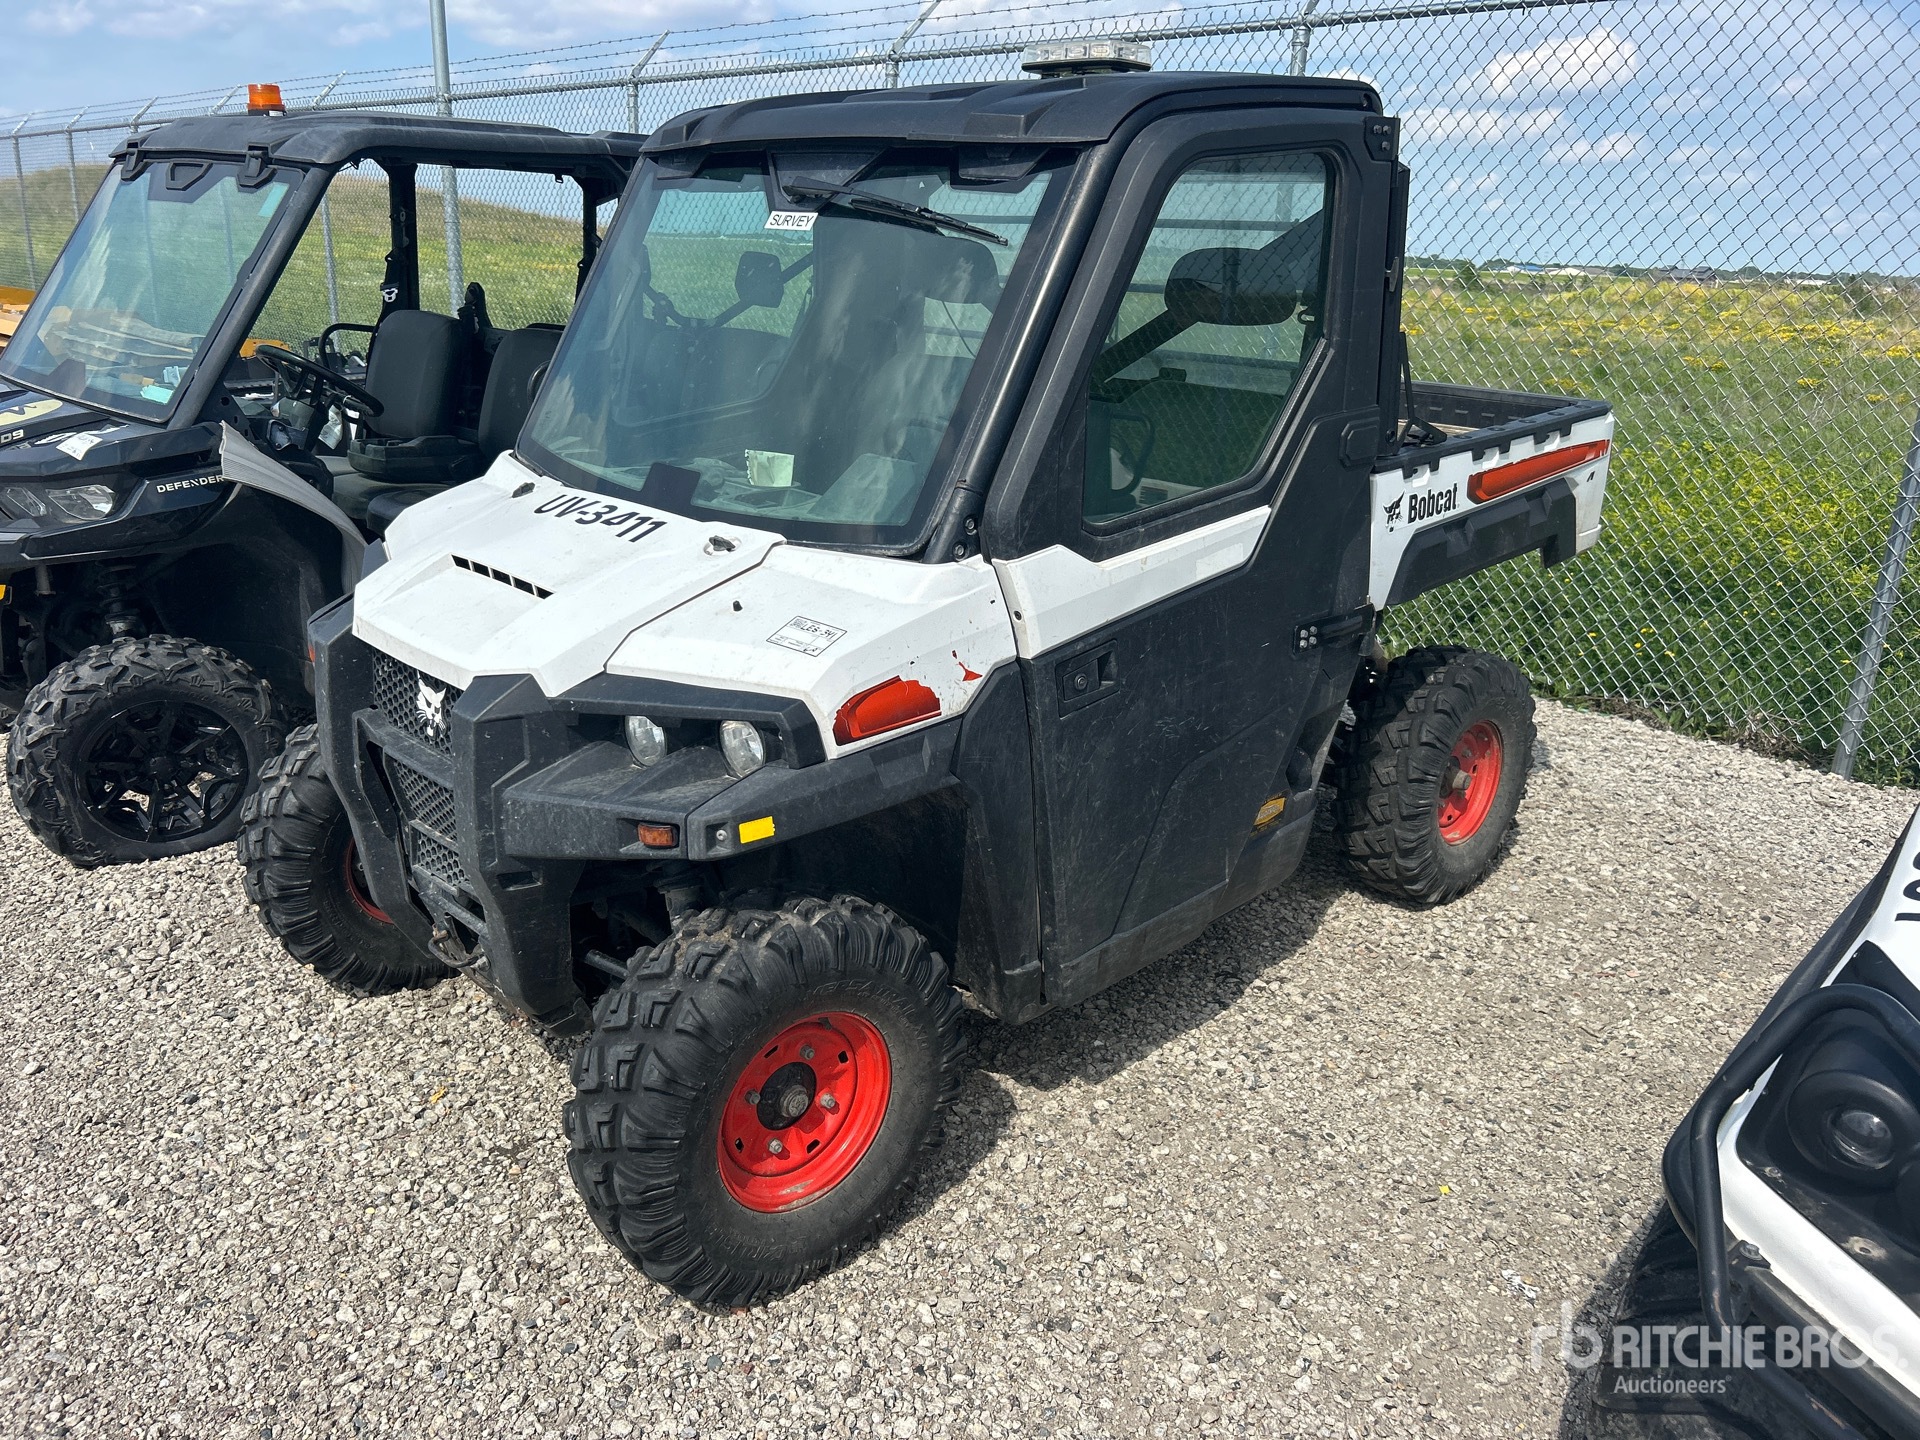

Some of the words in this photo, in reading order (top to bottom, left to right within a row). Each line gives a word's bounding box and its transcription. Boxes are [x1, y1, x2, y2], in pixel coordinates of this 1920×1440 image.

[769, 214, 815, 227] SURVEY
[156, 475, 225, 493] DEFENDER
[1408, 483, 1458, 524] Bobcat
[534, 494, 668, 543] UV-3411
